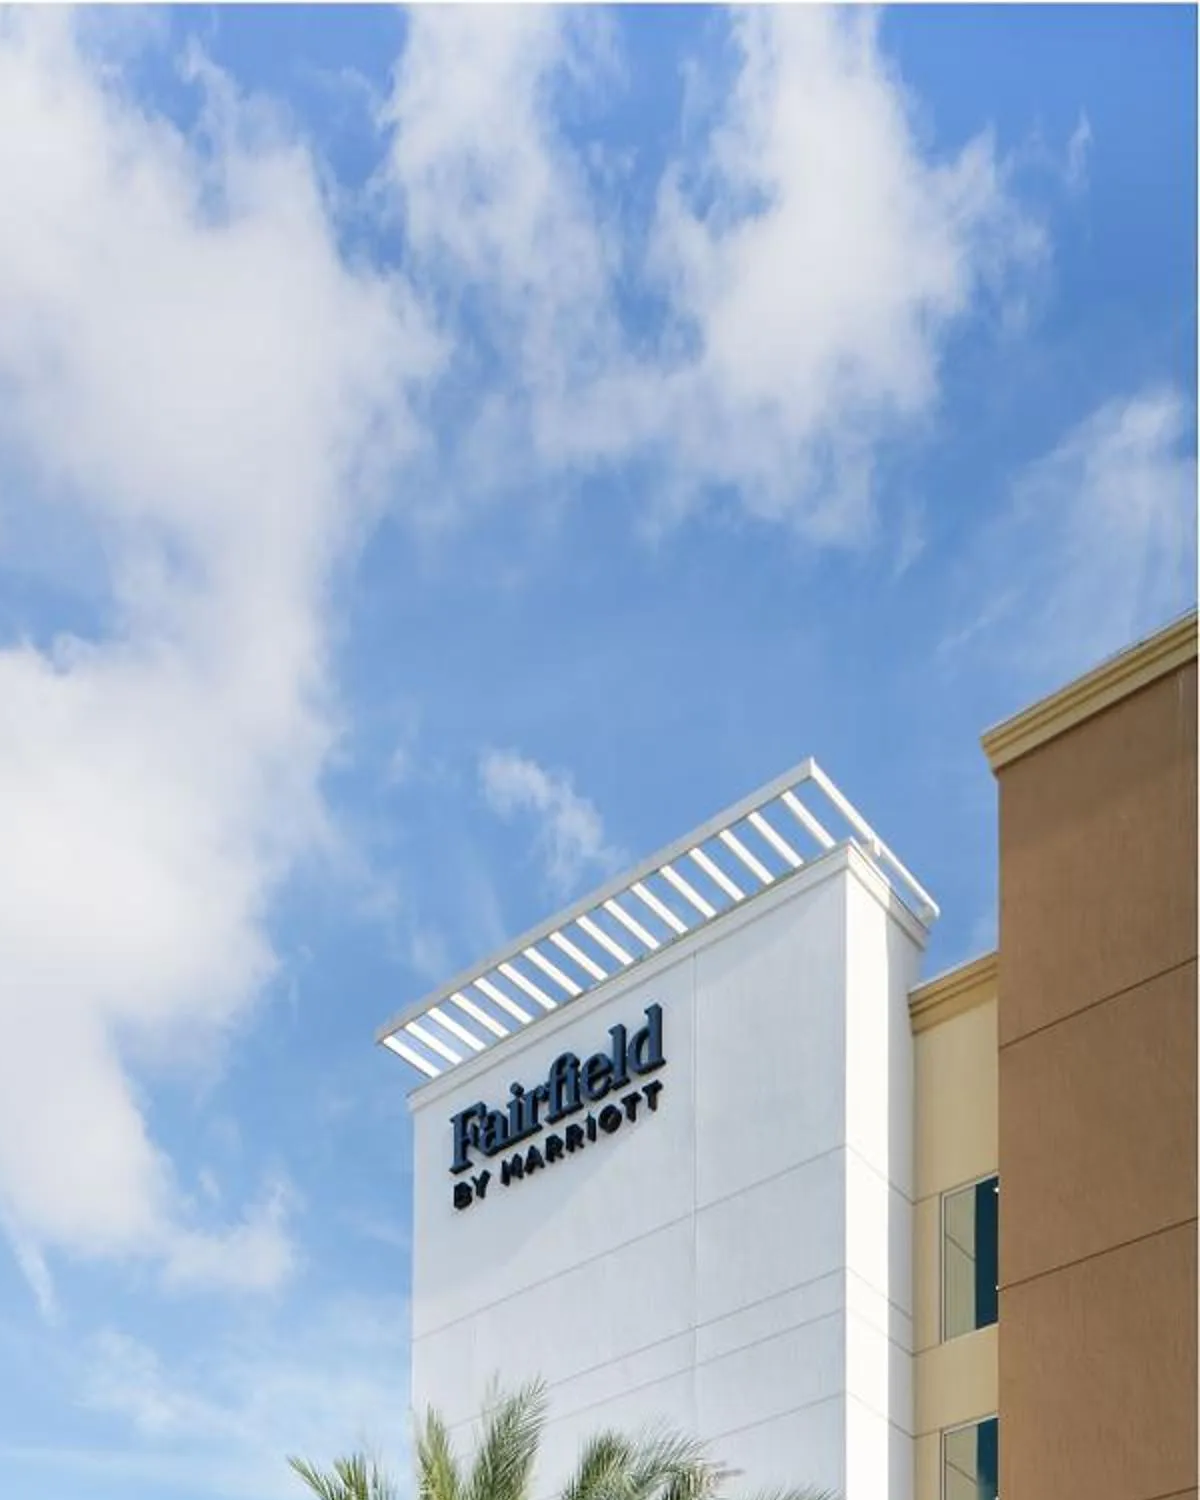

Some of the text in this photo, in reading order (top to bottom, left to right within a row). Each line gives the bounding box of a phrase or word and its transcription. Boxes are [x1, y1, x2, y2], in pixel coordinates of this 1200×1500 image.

[449, 1003, 666, 1174] Fairfield
[453, 1079, 663, 1210] BY MARRIOTT
